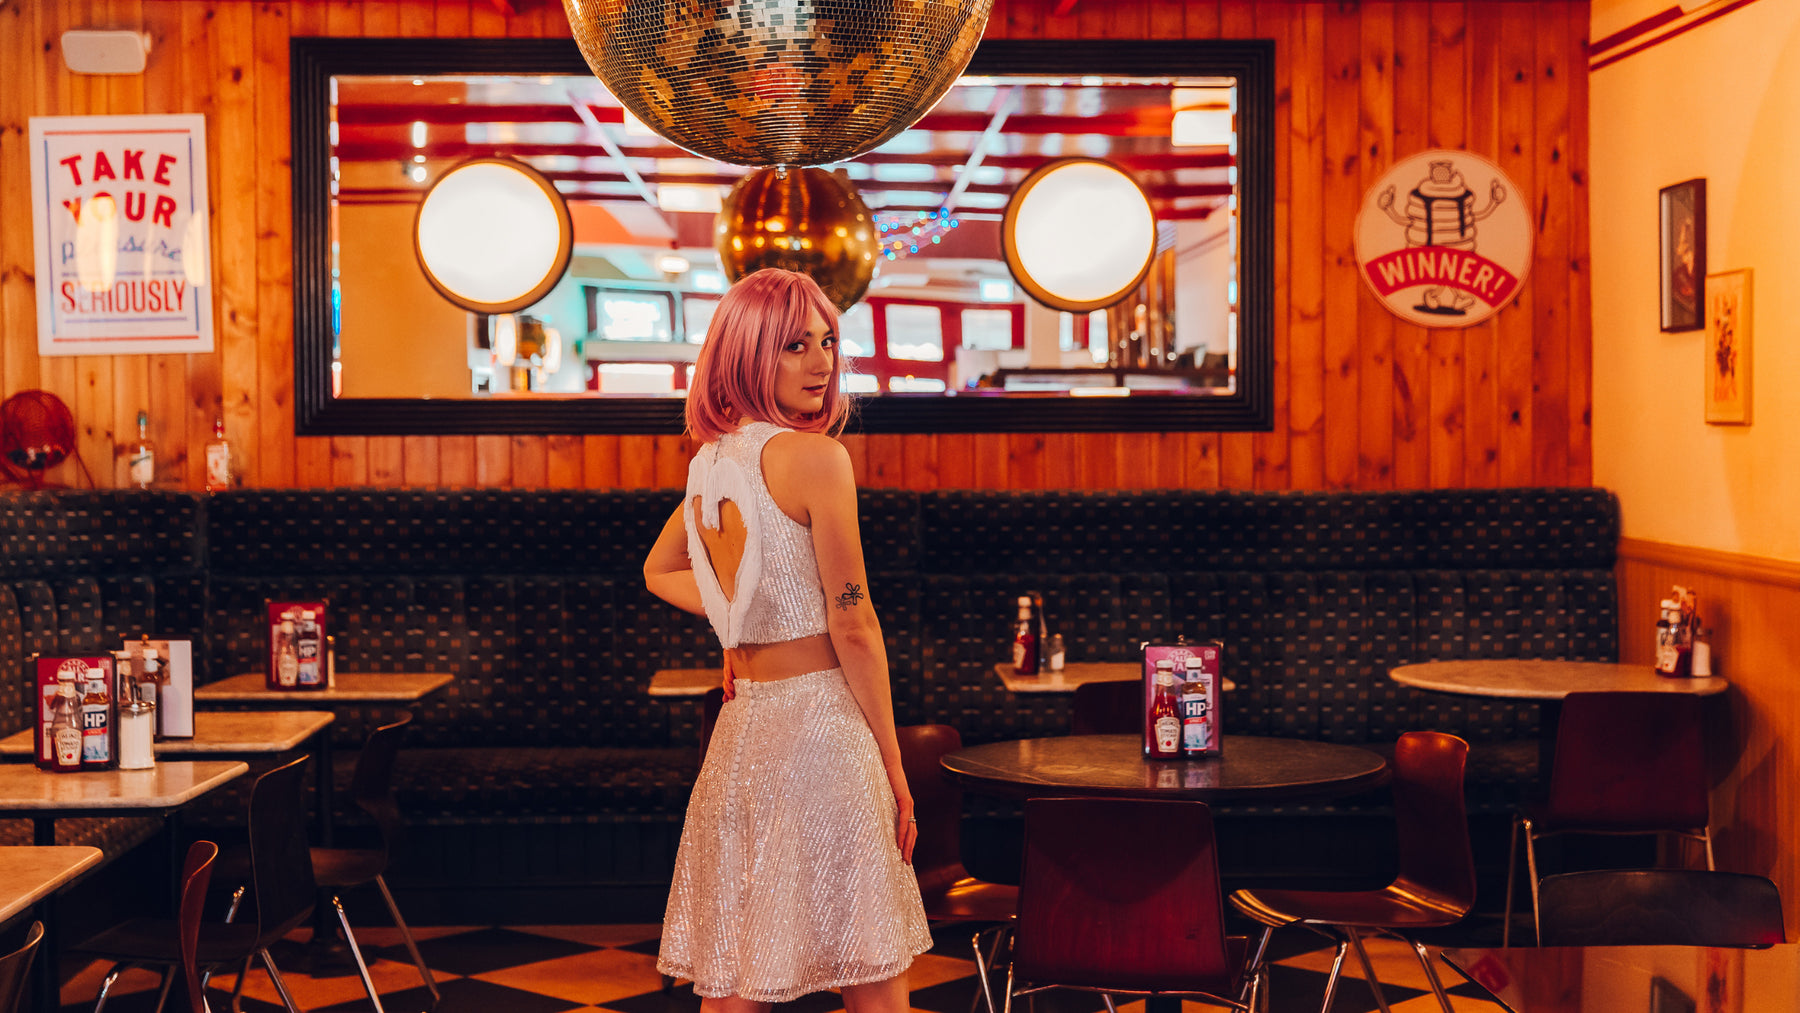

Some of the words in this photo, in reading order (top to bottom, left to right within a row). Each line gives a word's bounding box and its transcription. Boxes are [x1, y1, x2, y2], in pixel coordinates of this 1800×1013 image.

[59, 150, 177, 186] TAKE
[1378, 251, 1506, 299] WINNER!
[84, 712, 106, 728] HP
[1185, 702, 1206, 716] HP
